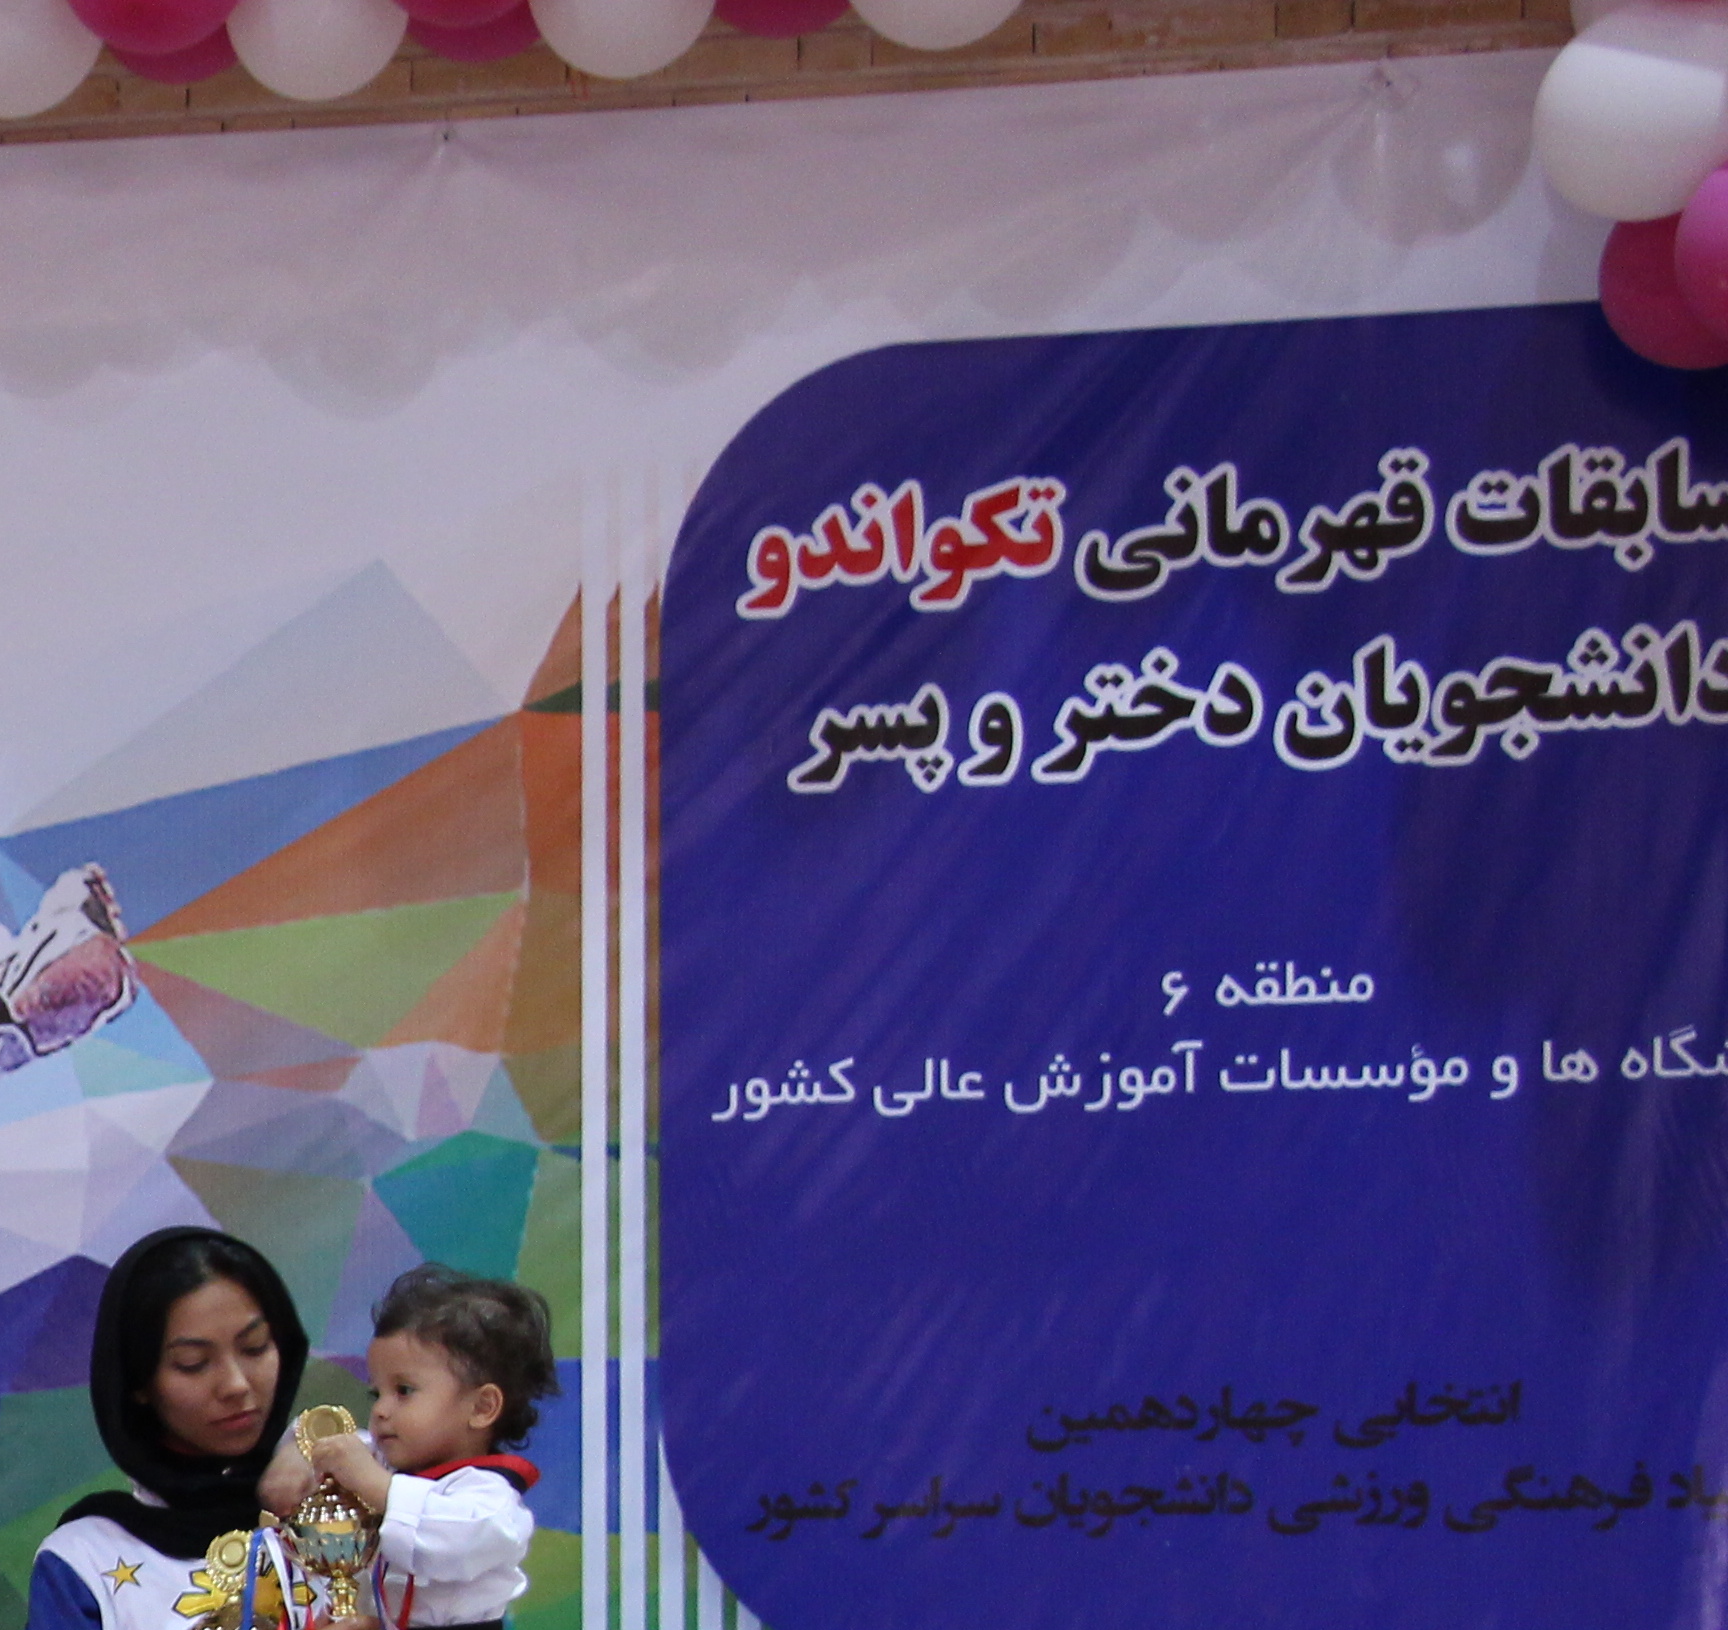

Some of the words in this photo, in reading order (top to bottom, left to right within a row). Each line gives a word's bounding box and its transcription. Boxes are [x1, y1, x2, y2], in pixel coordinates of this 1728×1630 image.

[735, 473, 1065, 619] تکواندو
[1074, 446, 1433, 601] قهرمانی
[786, 682, 946, 793] پسر
[957, 690, 1022, 787] و
[1031, 644, 1264, 783] دختر
[1160, 968, 1188, 1015] ۶
[1215, 962, 1375, 1009] منطقه
[712, 1058, 854, 1122] کشور
[871, 1057, 985, 1119] عالی
[1003, 1038, 1203, 1116] آموزش
[1218, 1043, 1469, 1103] مؤسسات
[1489, 1055, 1519, 1100] و
[1542, 1040, 1599, 1083] ها
[1025, 1386, 1320, 1452] چهاردهمین
[1331, 1380, 1522, 1449] انتخابی
[746, 1477, 856, 1542] کشور
[860, 1475, 1001, 1542] سراسر
[1013, 1469, 1254, 1530] دانشجویان
[1266, 1475, 1431, 1535] ورزشی
[1442, 1461, 1652, 1534] فرهنگی
